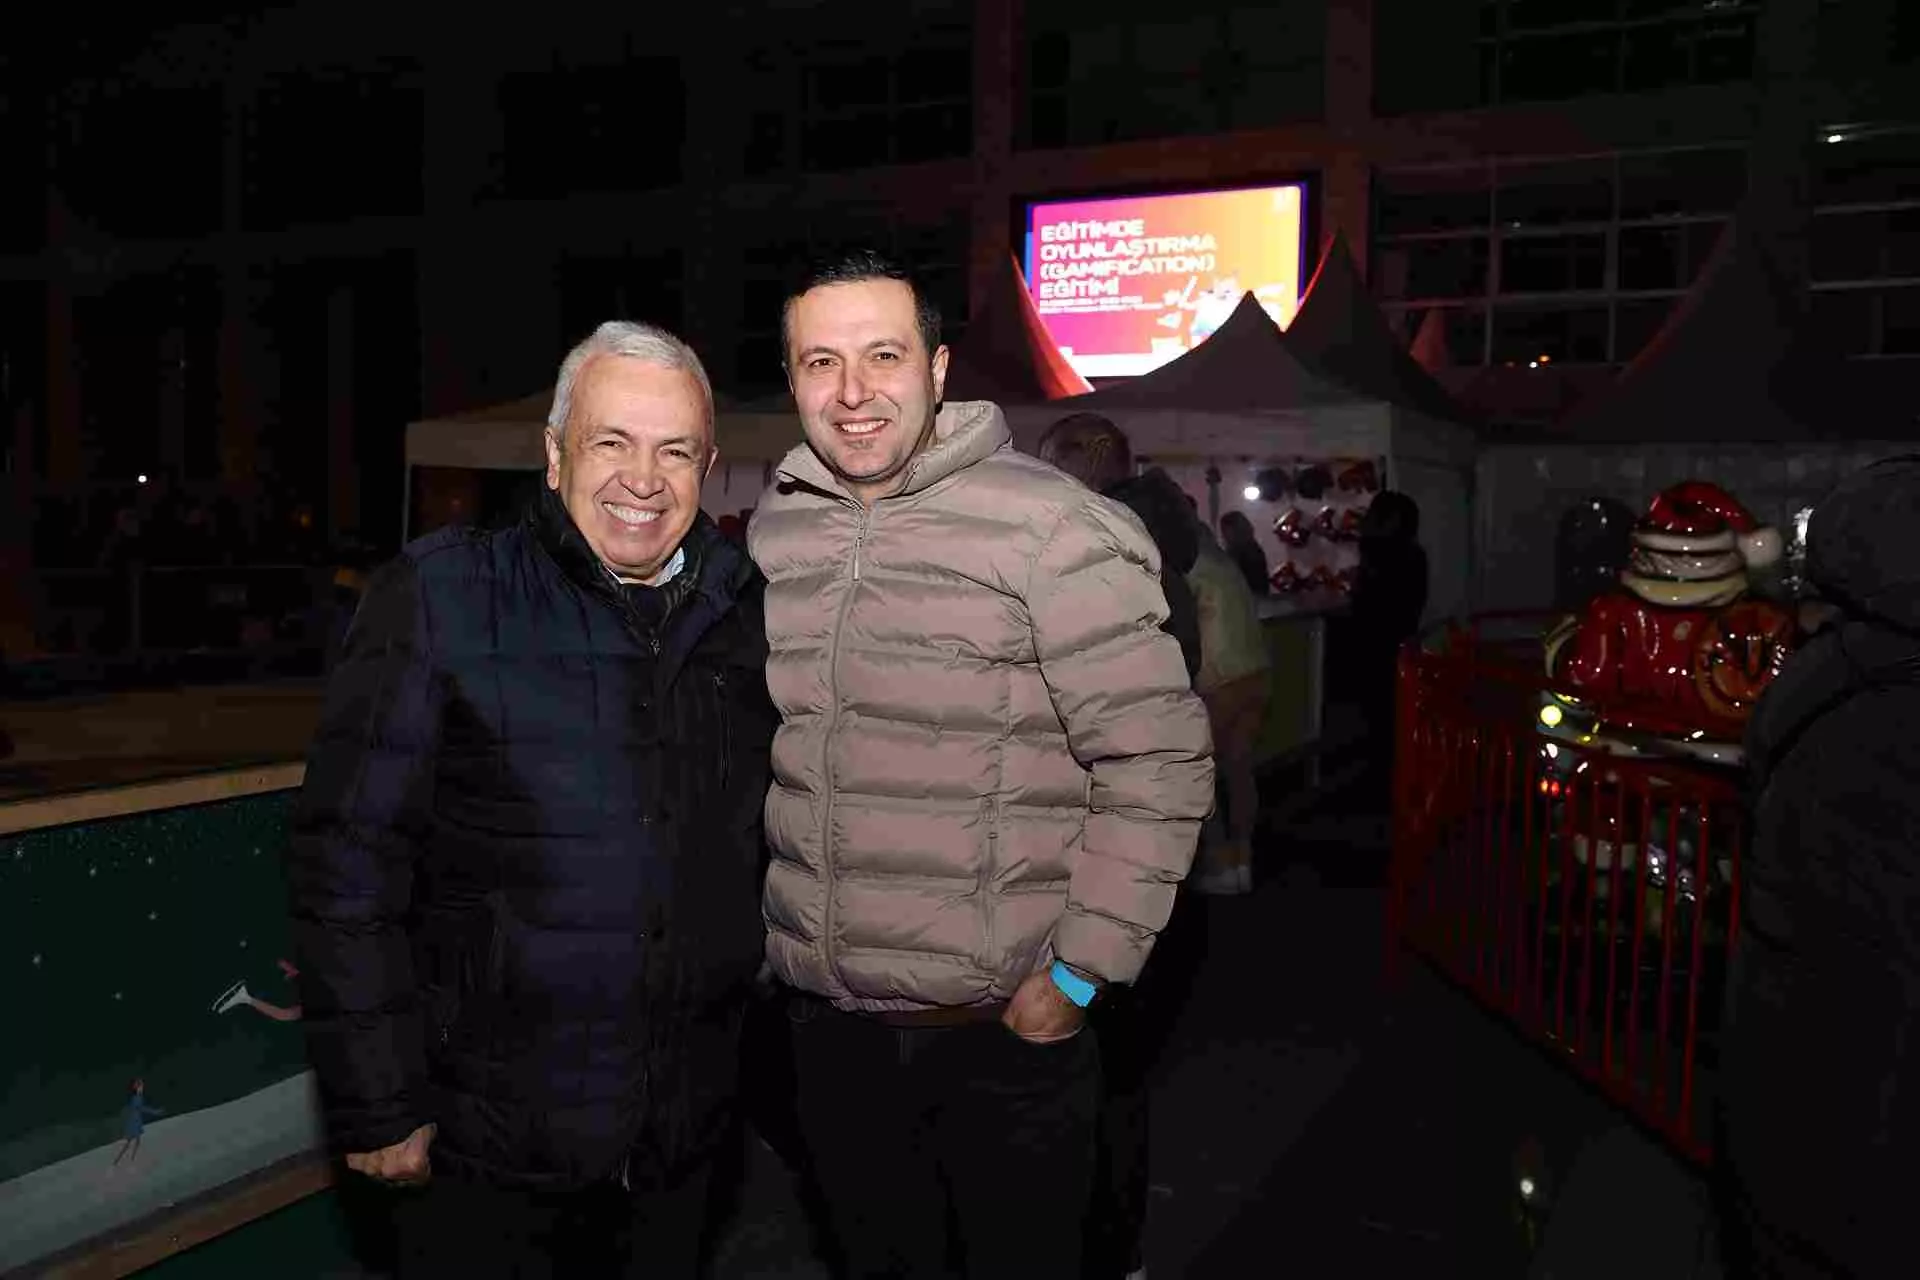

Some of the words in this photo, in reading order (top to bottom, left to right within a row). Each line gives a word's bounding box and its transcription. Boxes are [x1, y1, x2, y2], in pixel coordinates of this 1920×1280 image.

[1041, 218, 1144, 242] EĞİTİMDE
[1041, 233, 1217, 261] OYUNLAŞTIRMA
[1040, 253, 1216, 279] (GAMIFICATION)
[1040, 277, 1119, 299] EĞİTİMİ
